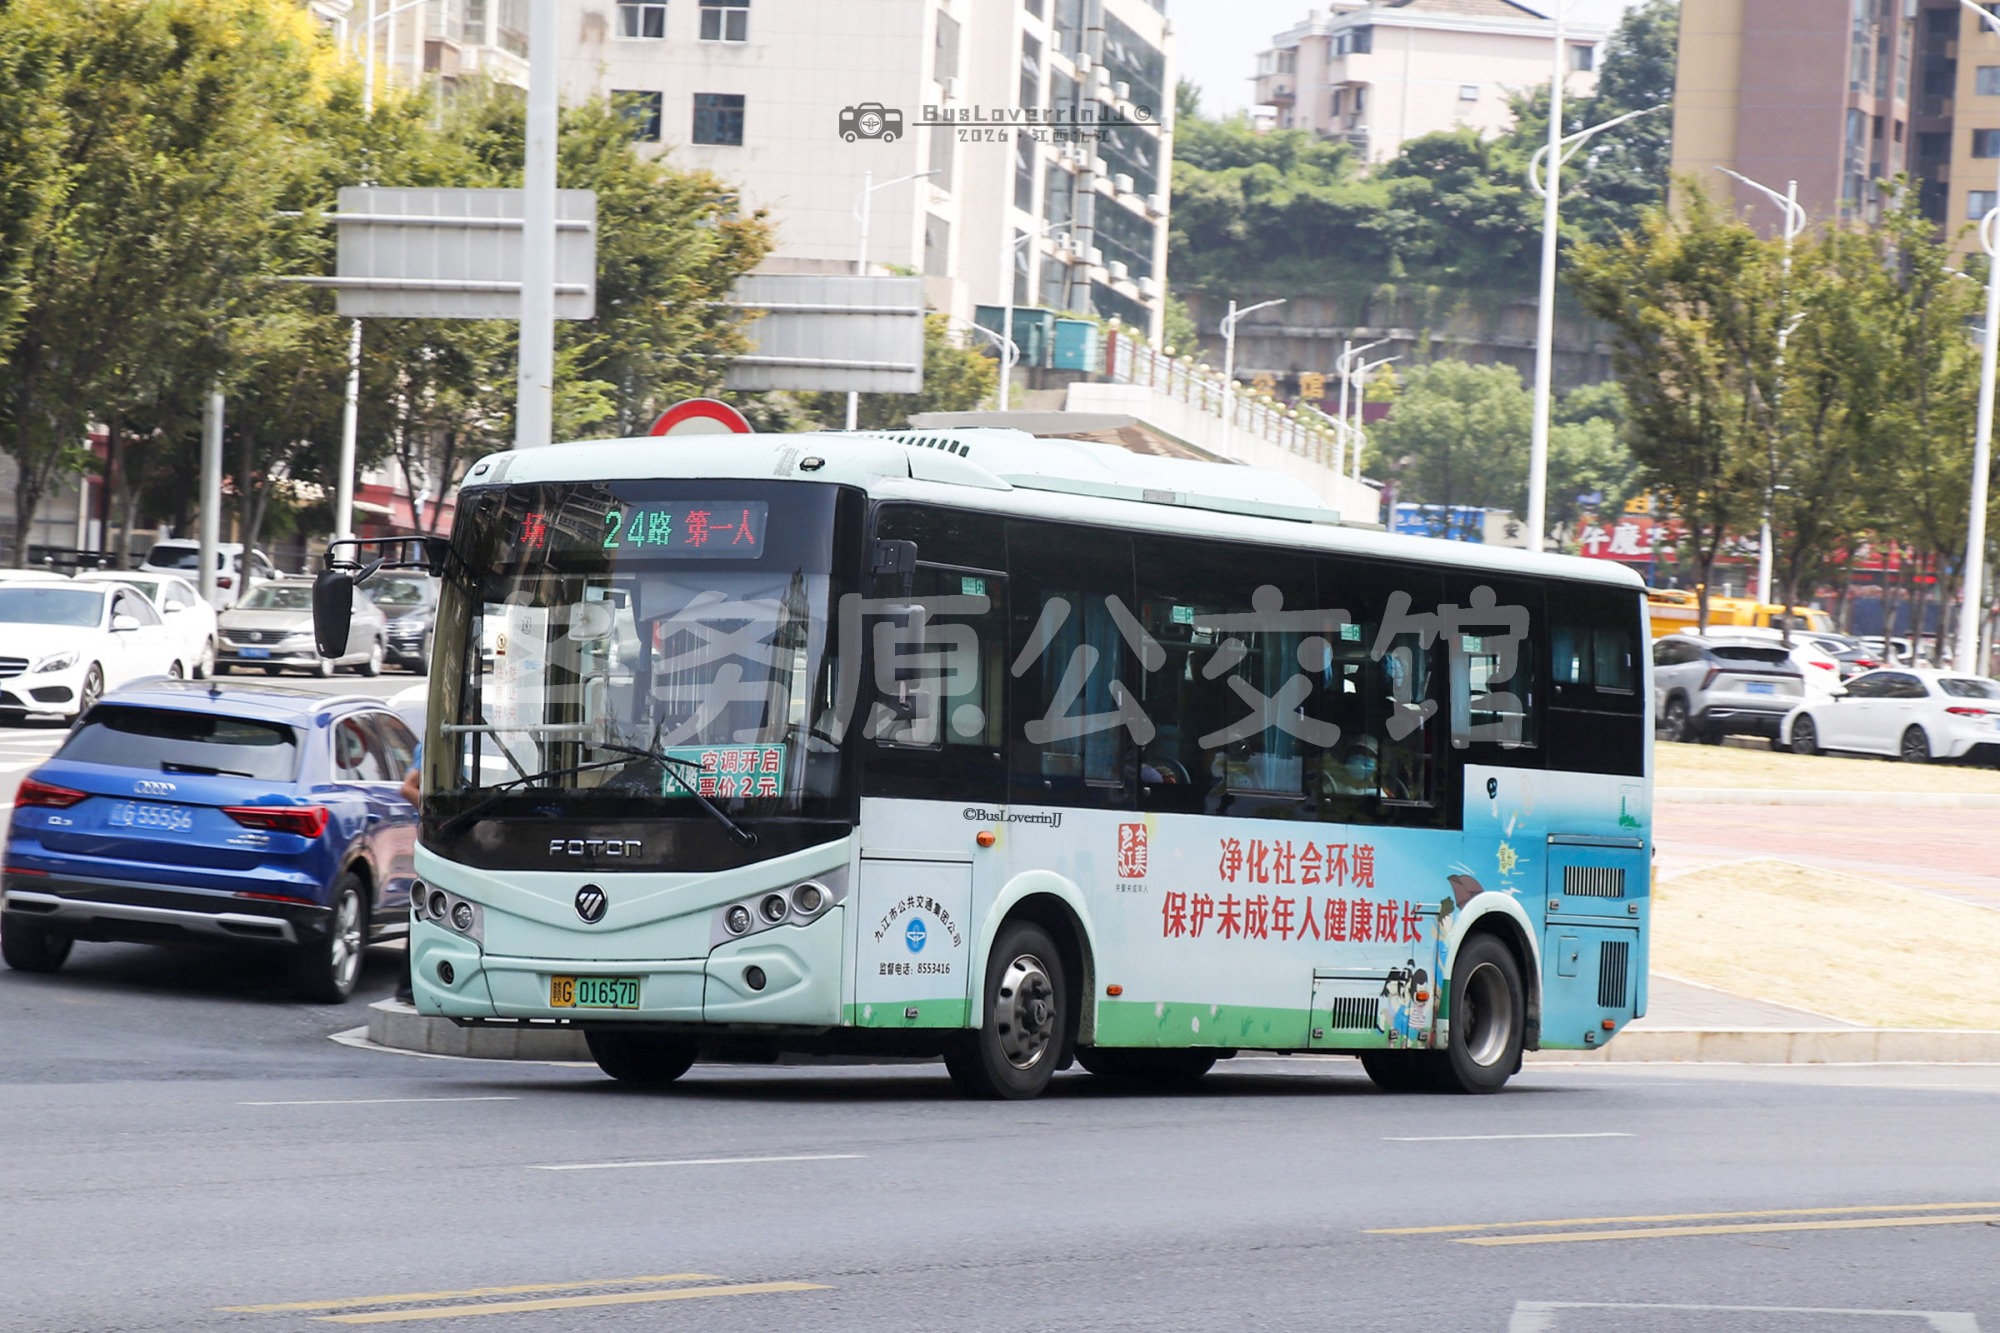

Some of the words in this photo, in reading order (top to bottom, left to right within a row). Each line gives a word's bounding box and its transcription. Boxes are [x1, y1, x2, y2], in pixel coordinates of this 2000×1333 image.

[603, 510, 673, 548] 24路
[684, 509, 756, 548] 第一人
[701, 750, 780, 774] 空调开启
[699, 777, 779, 798] 票价2元
[549, 839, 642, 857] FOTON
[1219, 837, 1375, 888] 净化社会环境
[874, 895, 962, 948] 九江市公共交通集团公司
[1162, 890, 1424, 943] 保护未成年人健康成长
[917, 962, 951, 975] 8553416
